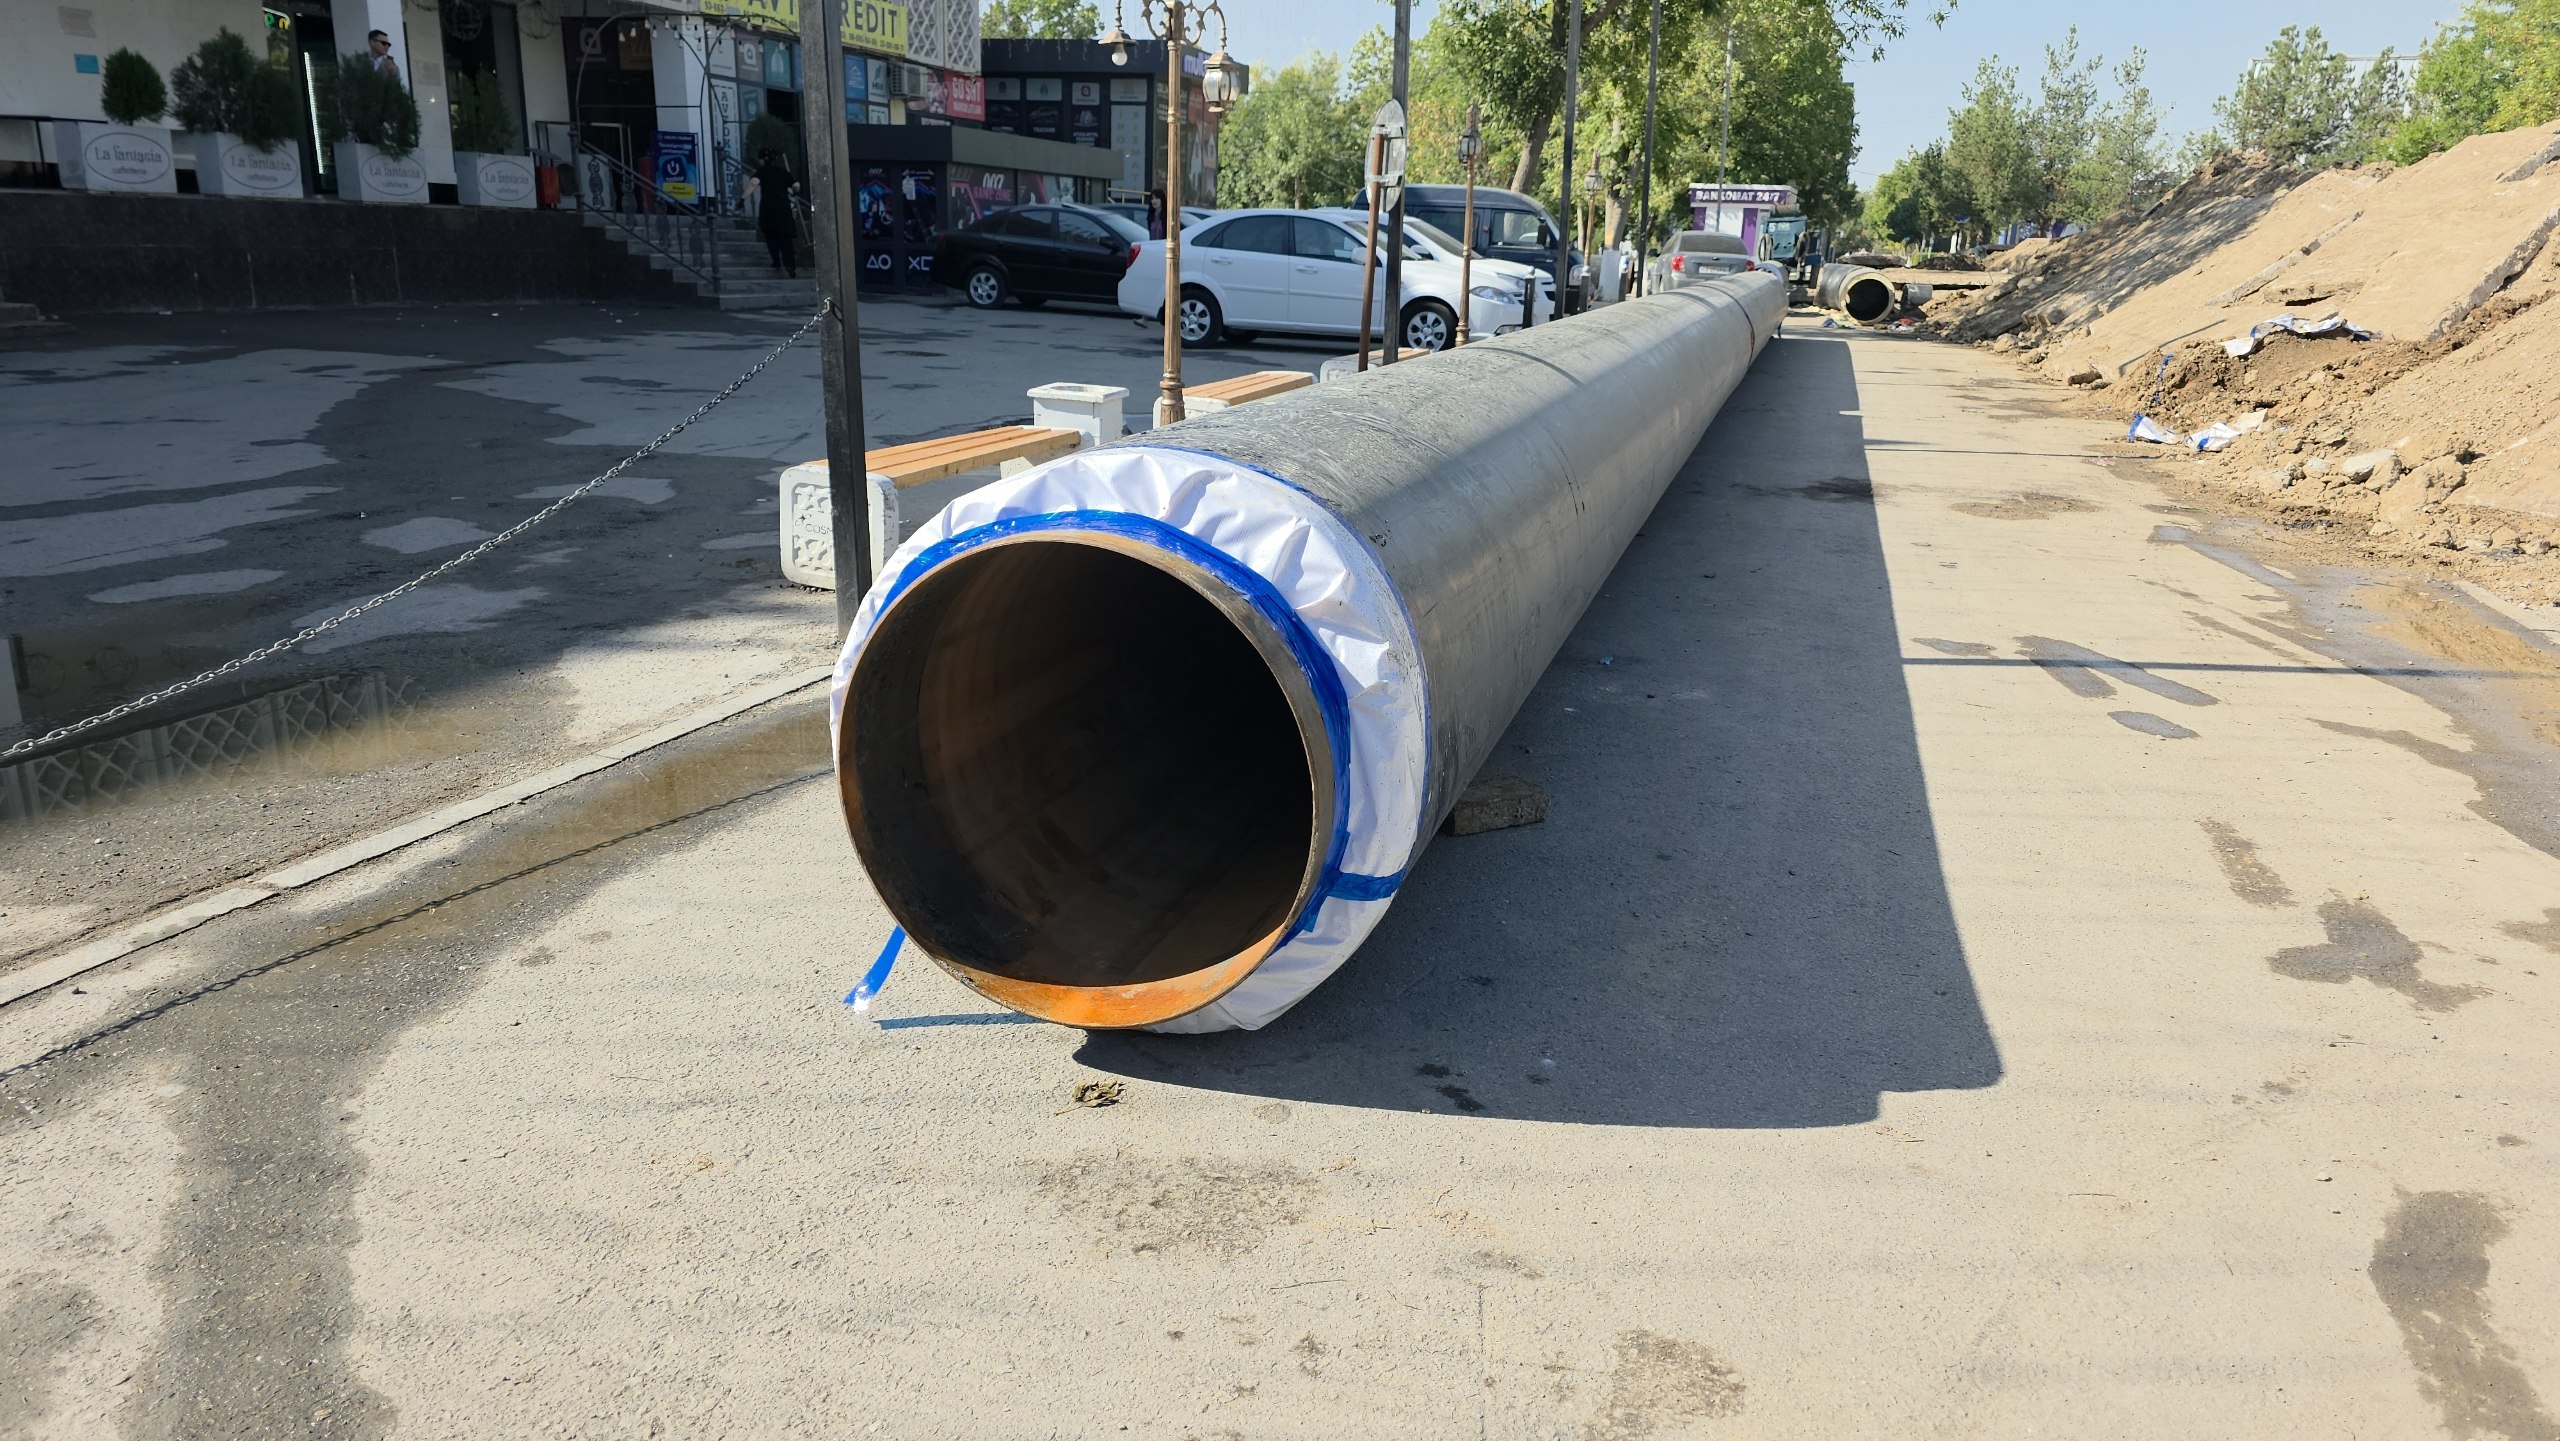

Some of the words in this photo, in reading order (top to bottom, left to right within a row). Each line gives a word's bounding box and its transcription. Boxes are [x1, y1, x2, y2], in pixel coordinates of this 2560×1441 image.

[841, 0, 898, 38] REDIT
[94, 146, 111, 161] La
[113, 144, 162, 163] fantasia
[231, 154, 246, 167] La
[982, 172, 1005, 189] 007
[973, 186, 995, 200] GAME
[995, 188, 1012, 202] ZONE
[805, 523, 833, 535] COSM
